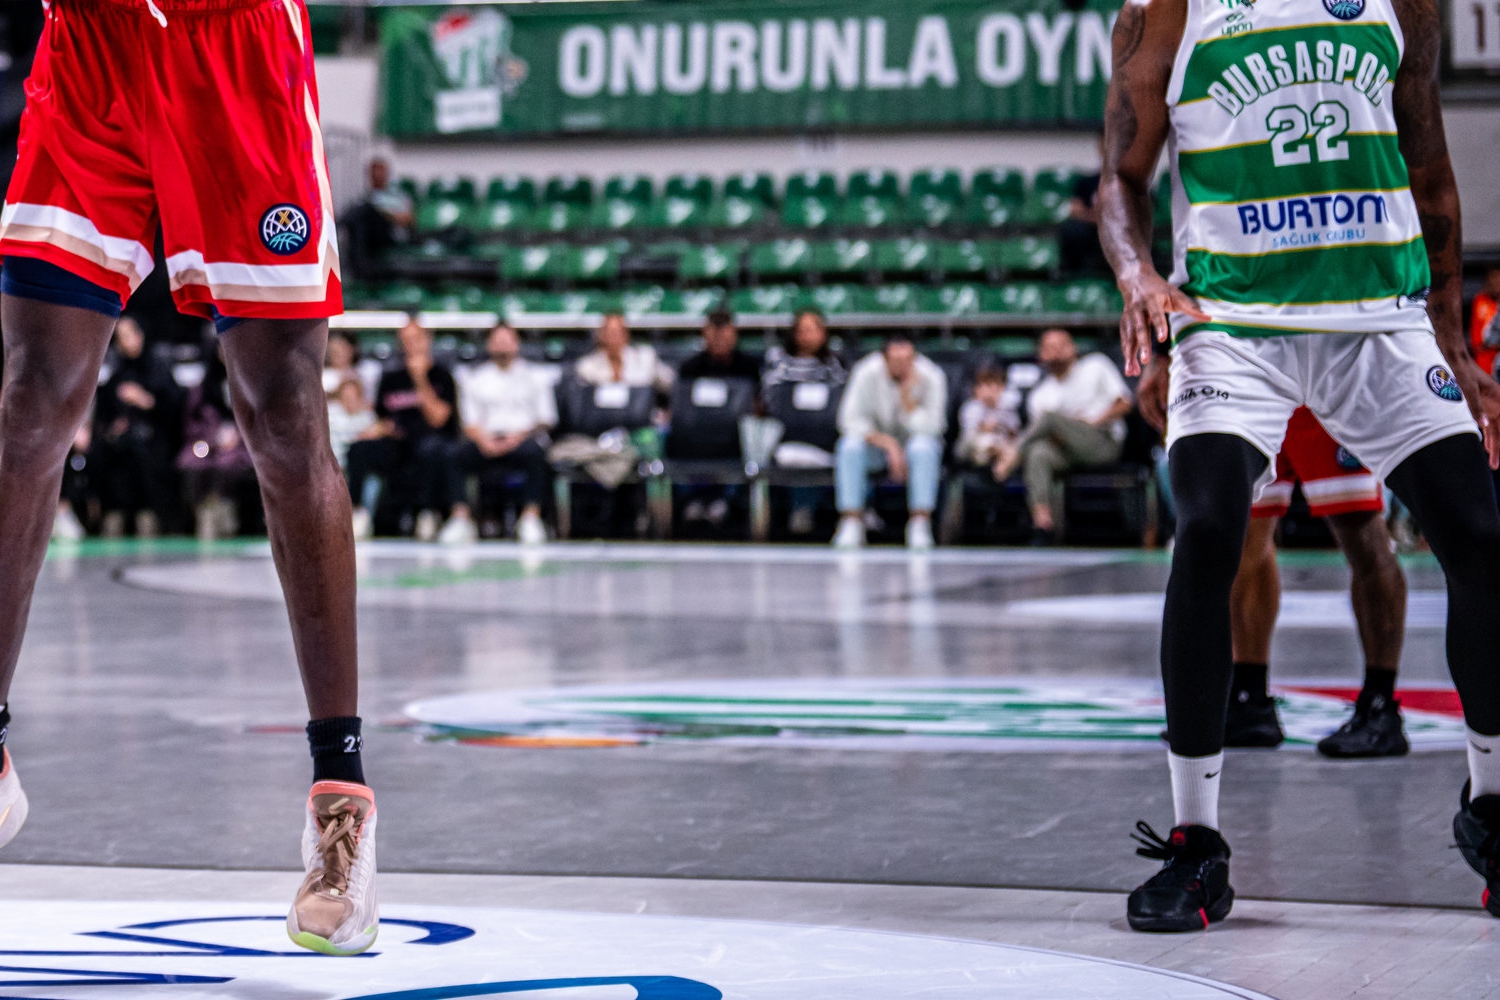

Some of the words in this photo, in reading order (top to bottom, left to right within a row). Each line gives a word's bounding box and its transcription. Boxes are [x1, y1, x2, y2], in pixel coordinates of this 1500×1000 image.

[558, 14, 959, 98] ONURUNLA
[1207, 40, 1389, 118] BURSASPOR
[1267, 101, 1349, 167] 22
